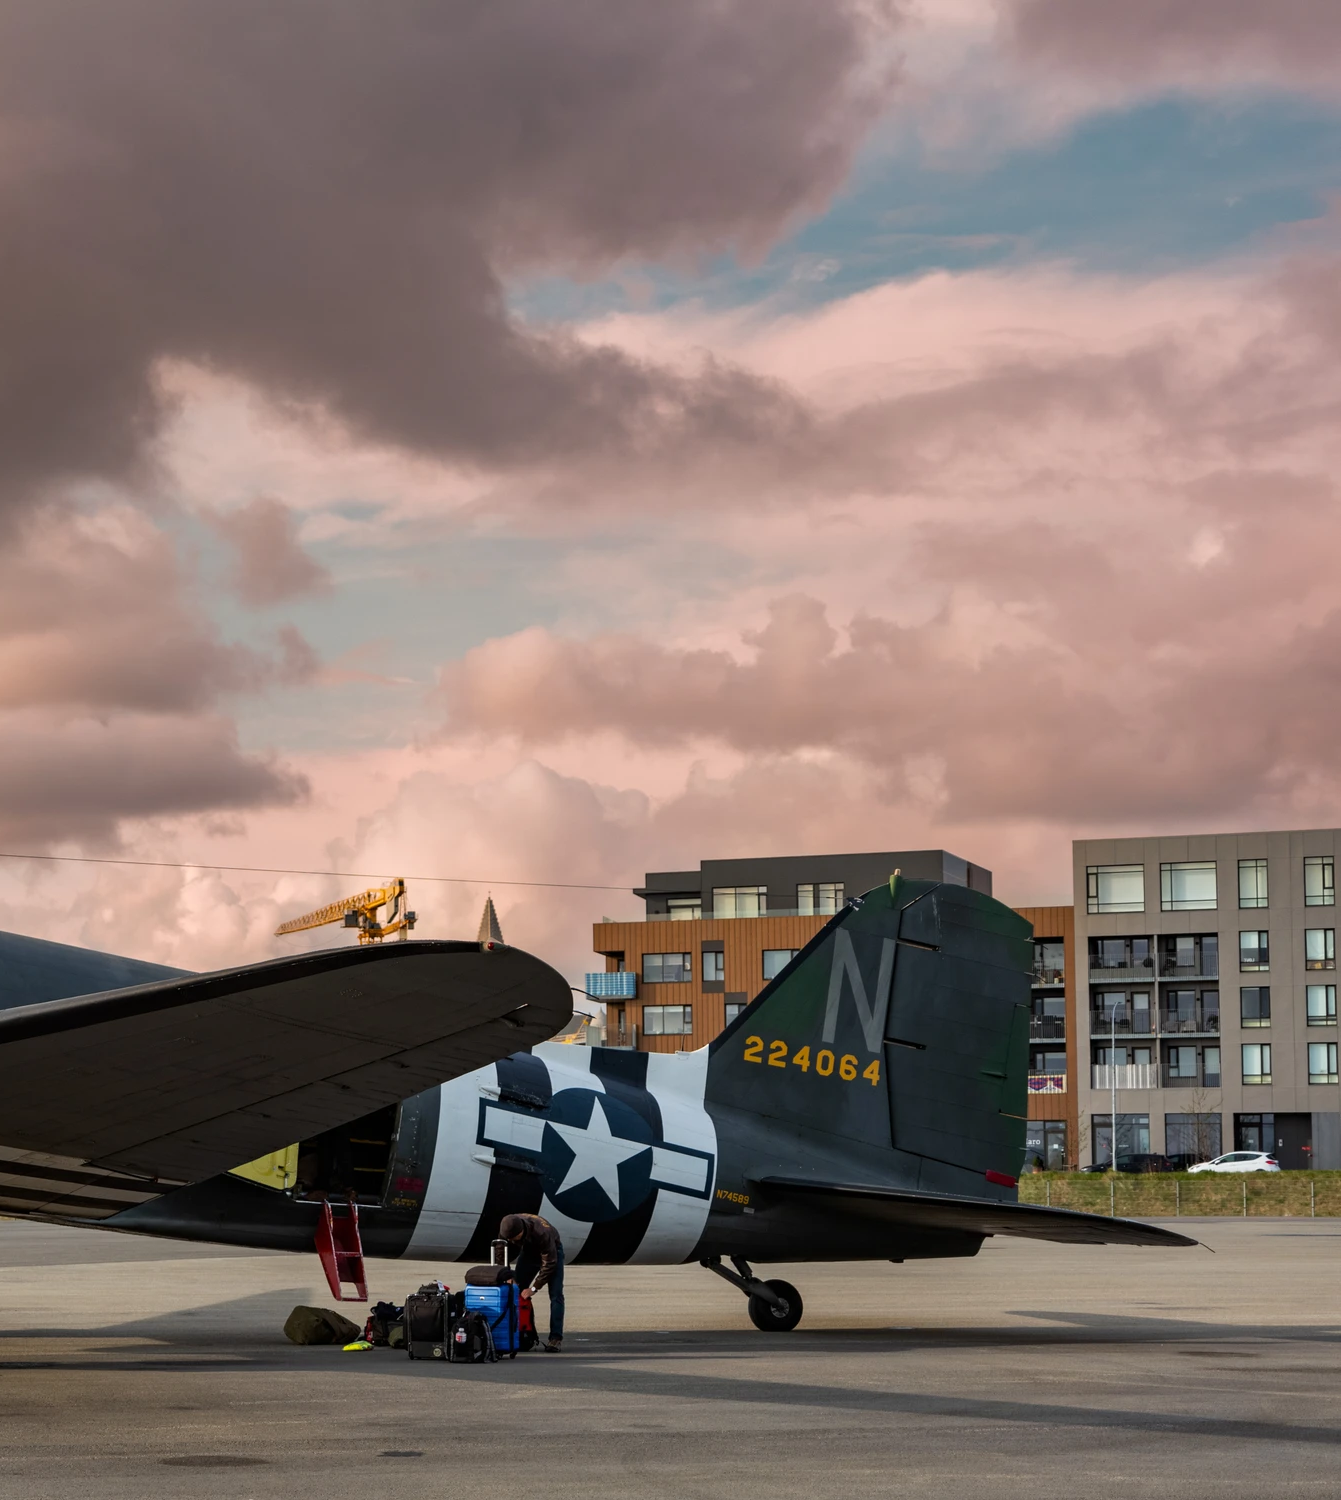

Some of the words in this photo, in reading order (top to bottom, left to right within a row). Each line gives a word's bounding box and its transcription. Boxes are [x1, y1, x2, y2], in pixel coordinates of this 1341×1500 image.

[822, 926, 896, 1054] N
[743, 1035, 881, 1087] 224064
[716, 1189, 750, 1205] N74589
